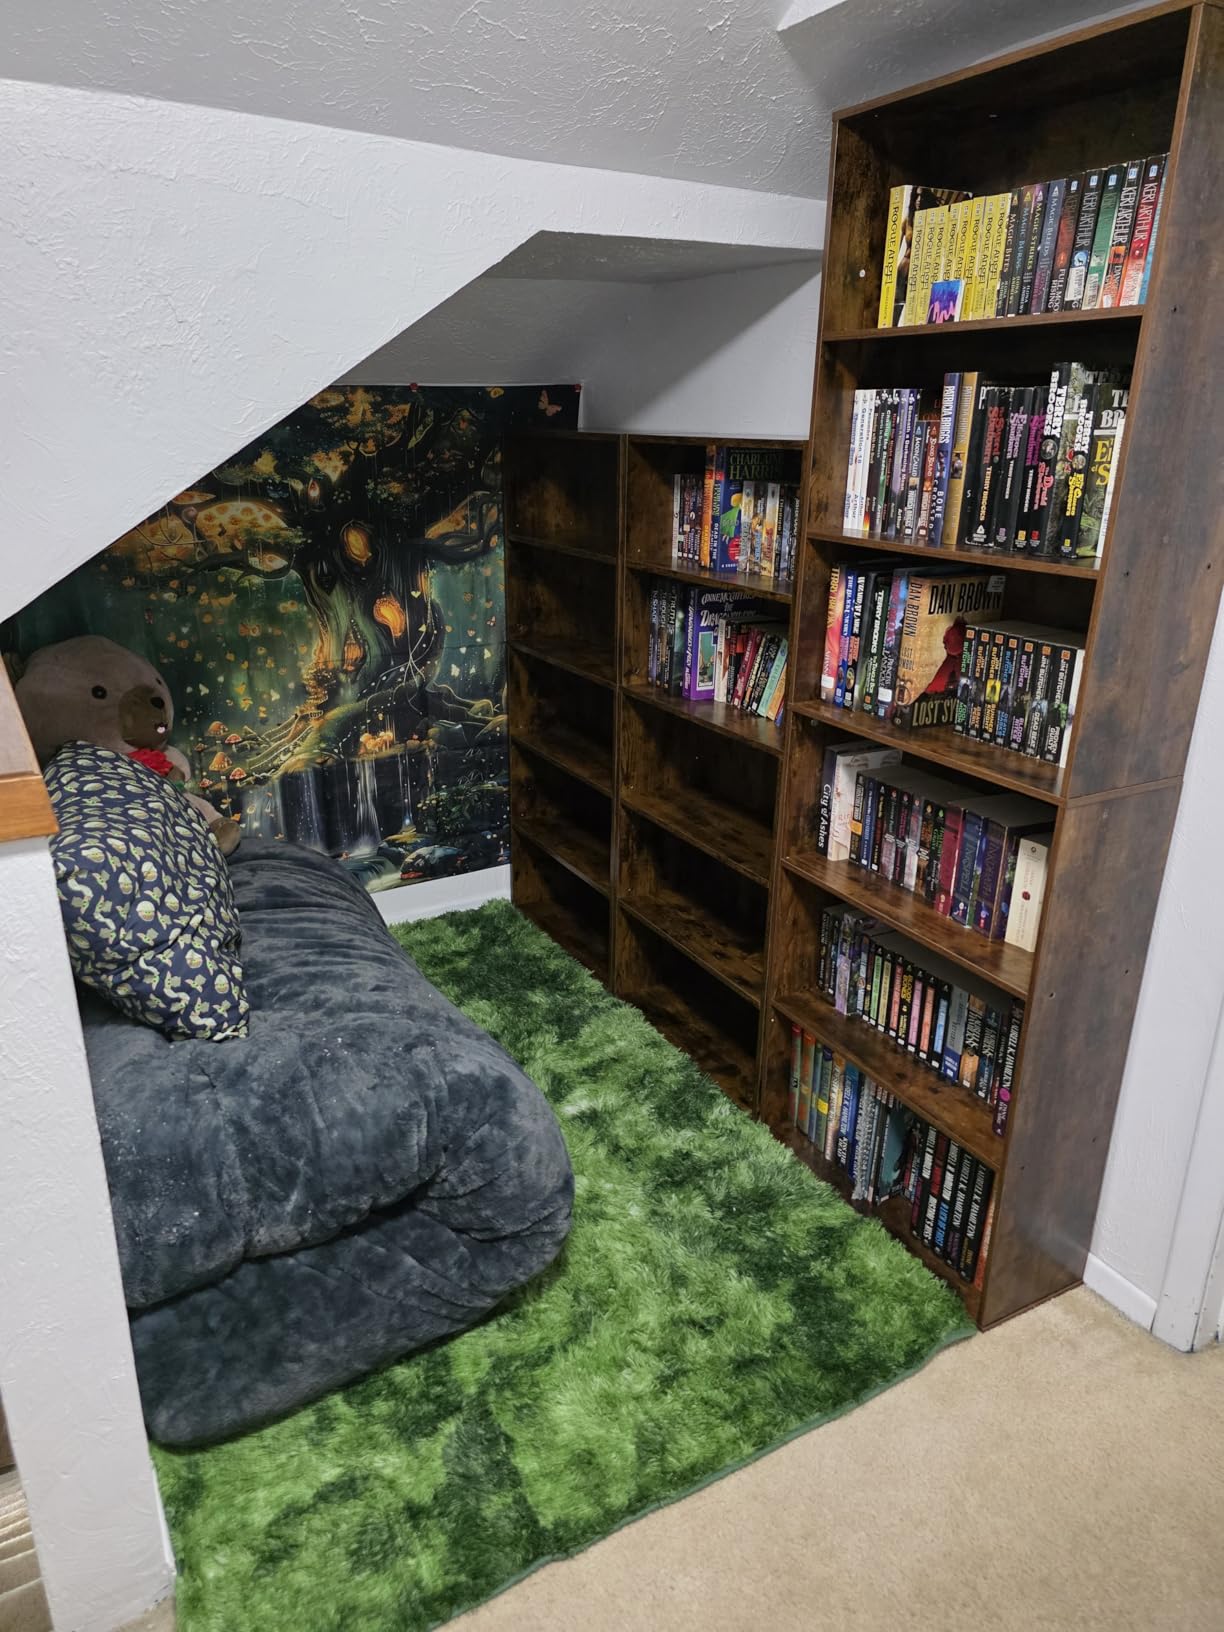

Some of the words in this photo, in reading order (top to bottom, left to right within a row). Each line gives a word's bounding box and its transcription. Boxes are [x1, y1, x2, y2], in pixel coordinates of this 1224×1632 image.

[1082, 189, 1099, 212] KERI
[1120, 184, 1137, 208] KERI
[1142, 180, 1158, 205] KERI
[889, 205, 899, 246] ROGUE
[1019, 207, 1030, 238] MAGIC
[1032, 202, 1043, 234] MAGIC
[1049, 198, 1058, 226] MAGIC
[1113, 206, 1133, 247] ARTHUR
[1135, 204, 1153, 244] ARTHUR
[926, 227, 935, 260] ROGUE
[935, 226, 944, 261] ROGUE
[948, 223, 956, 257] ROGUE
[959, 220, 968, 254] ROGUE
[971, 219, 980, 254] ROGUE
[984, 217, 993, 251] ROGUE
[996, 212, 1005, 247] ROGUE
[1007, 213, 1016, 247] MAGIC
[1076, 212, 1095, 249] ARTHUR
[913, 229, 922, 263] ROGUE
[1003, 248, 1012, 273] BITES
[1015, 240, 1025, 270] BURNS
[1026, 235, 1038, 270] STRIKES
[1048, 279, 1058, 308] RISING
[1058, 268, 1066, 287] FULL
[942, 384, 955, 416] PATRICIA
[1044, 369, 1060, 437] BROOKS
[1051, 384, 1067, 438] TERRY
[939, 416, 952, 444] BRIGGS
[1075, 398, 1088, 452] BROOKS
[1081, 410, 1093, 453] TERRY
[902, 439, 910, 472] Darkening
[984, 465, 992, 490] TERRY
[930, 479, 938, 529] CROSSED
[935, 490, 944, 519] BONE
[979, 489, 989, 522] BROOKS
[876, 590, 885, 620] TERRY
[910, 582, 922, 602] DAN
[929, 582, 956, 616] DAN
[872, 619, 881, 653] BROOKS
[905, 604, 919, 638] BROWN
[961, 641, 969, 673] BUTCHER
[975, 645, 983, 678] BUTCHER
[989, 646, 997, 679] BUTCHER
[1003, 650, 1011, 683] BUTCHER
[1018, 655, 1027, 688] BUTCHER
[1036, 668, 1044, 700] BUTCHER
[1055, 672, 1064, 705] BUTCHER
[912, 700, 940, 727] LOST
[988, 703, 996, 733] SUMMER
[1032, 711, 1040, 731] DEAD
[1016, 717, 1024, 743] BLOOD
[1047, 727, 1055, 751] GUILTY
[1052, 726, 1060, 754] PROVEN
[821, 783, 832, 807] City
[820, 807, 829, 816] of
[817, 816, 829, 848] Ashes
[959, 844, 974, 893] INKSPELL
[900, 975, 910, 999] BONES
[906, 975, 915, 1003] BLOODY
[1009, 1018, 1020, 1047] LAURELL
[1002, 1055, 1014, 1089] HAMILTON
[839, 1106, 850, 1135] HAMILTON
[959, 1154, 973, 1184] LAURELL
[974, 1165, 988, 1195] LAURELL
[951, 1191, 967, 1228] HAMILTON
[965, 1201, 981, 1239] HAMILTON
